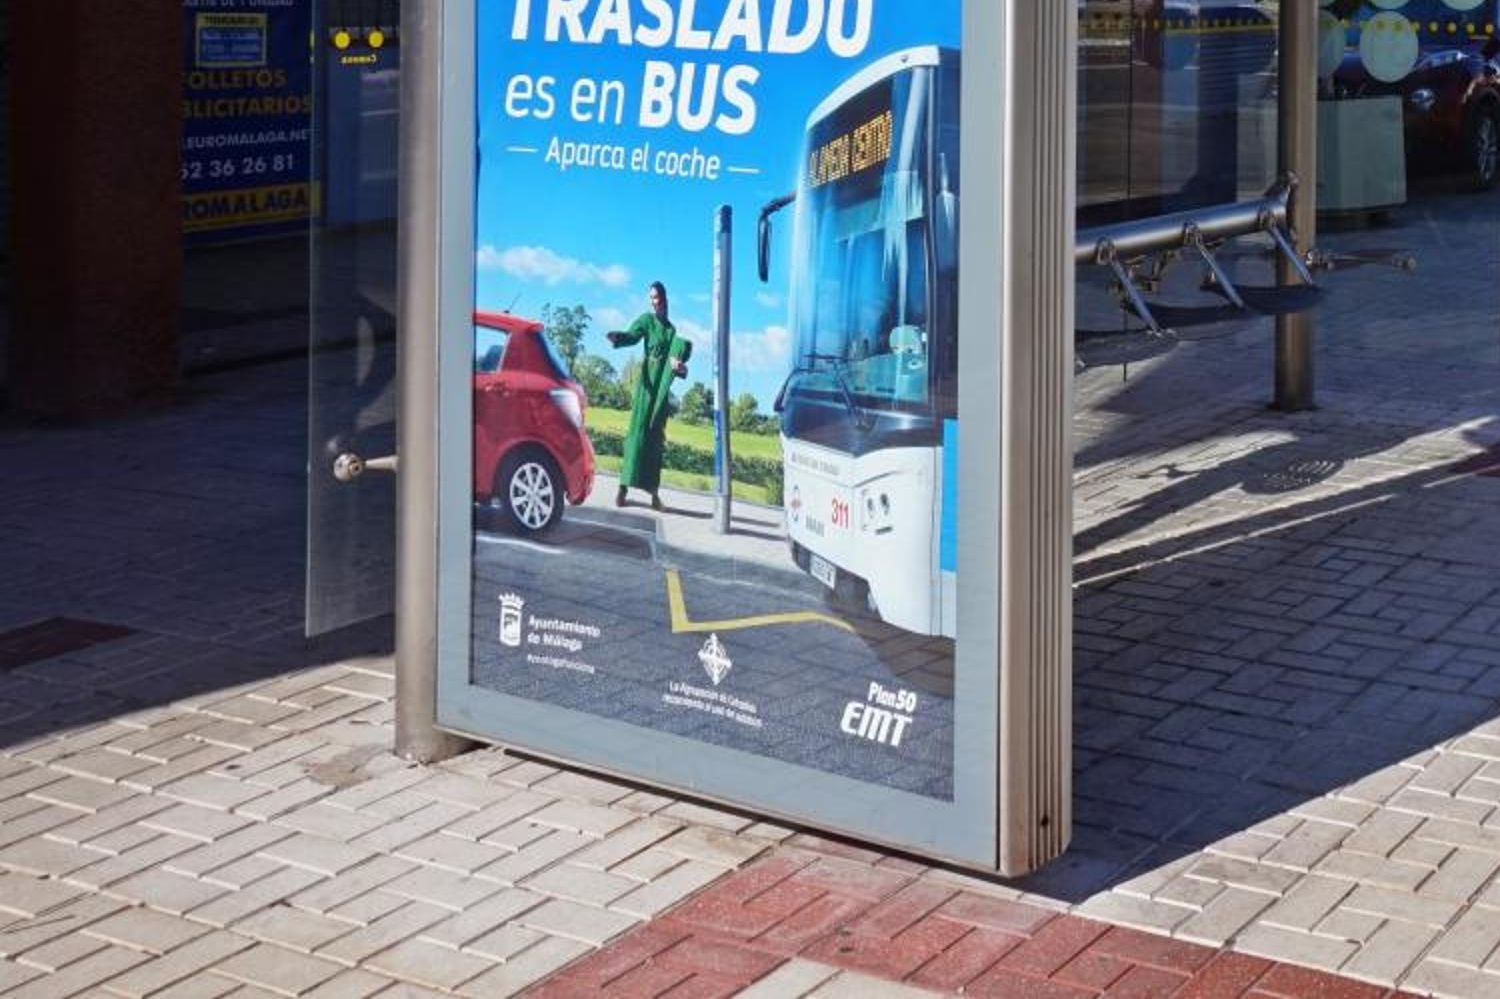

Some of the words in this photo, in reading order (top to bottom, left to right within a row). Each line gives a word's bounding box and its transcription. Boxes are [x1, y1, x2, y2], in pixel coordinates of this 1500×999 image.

[504, 73, 556, 119] es
[570, 76, 625, 124] en
[639, 61, 761, 135] BUS
[209, 159, 236, 178] 36
[242, 156, 267, 175] 26
[272, 152, 294, 172] 81
[545, 137, 624, 170] Aparca
[631, 143, 649, 172] el
[655, 148, 720, 179] coche
[832, 497, 849, 530] 311
[841, 701, 913, 747] EMT
